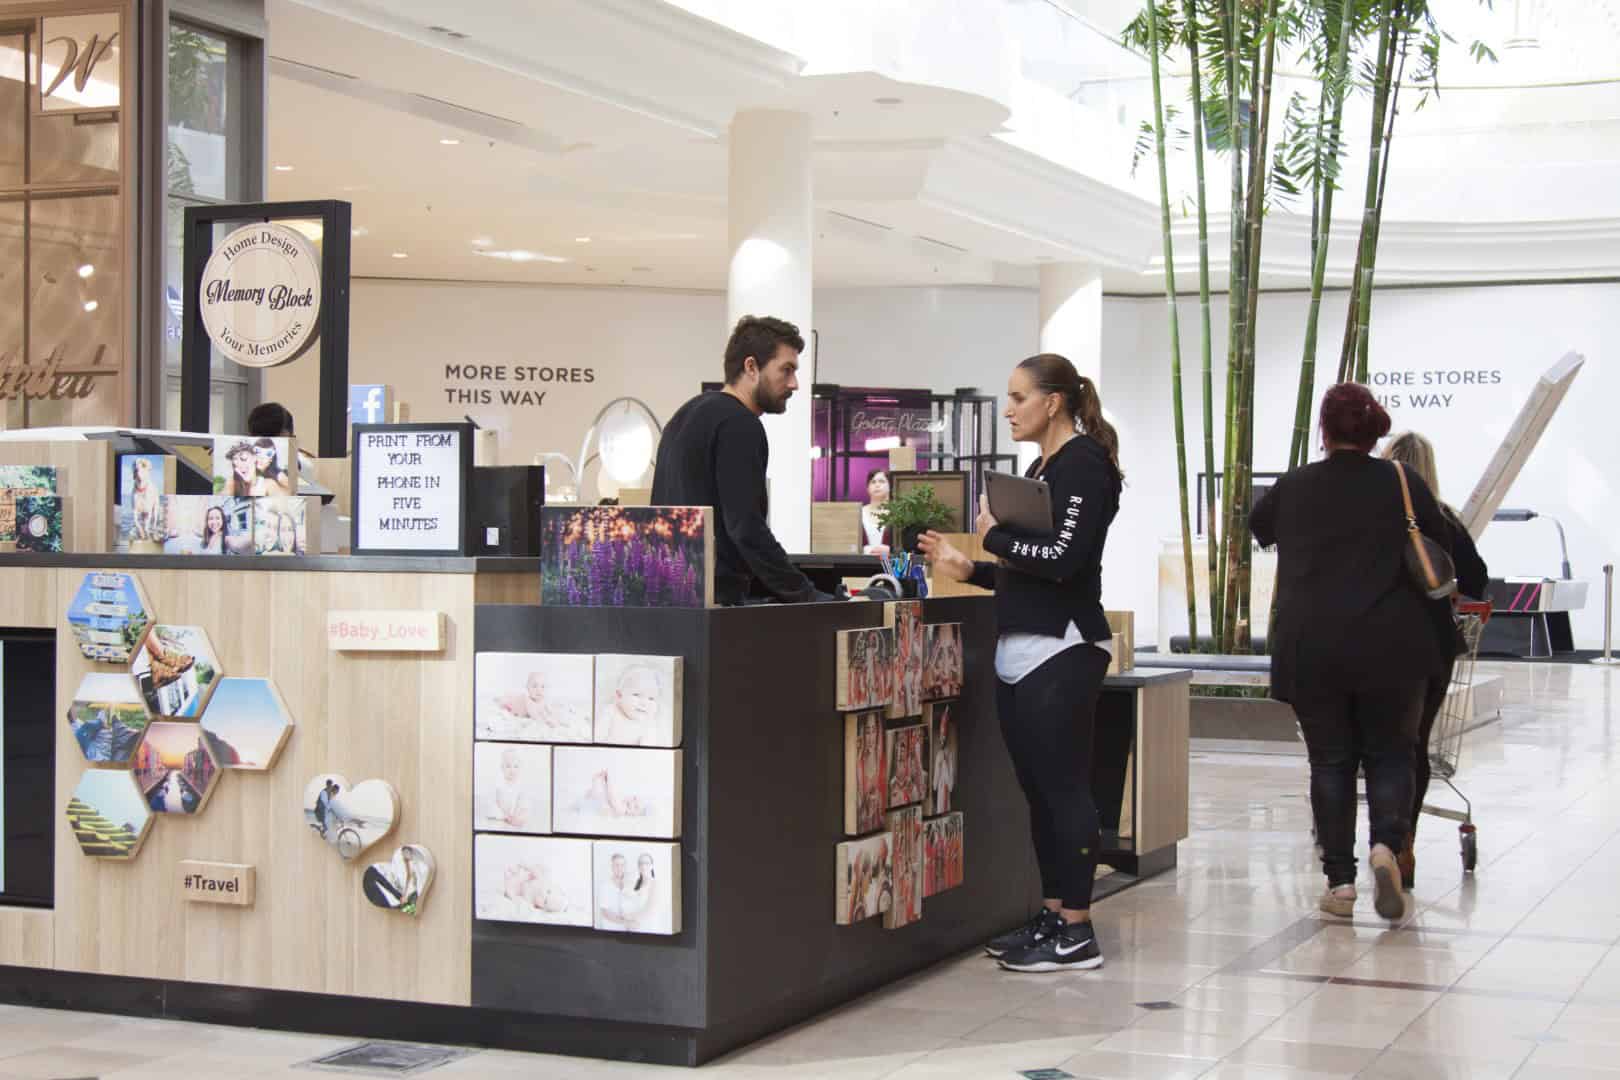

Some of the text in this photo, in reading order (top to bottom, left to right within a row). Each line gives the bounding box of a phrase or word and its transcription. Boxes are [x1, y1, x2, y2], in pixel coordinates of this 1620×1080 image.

[223, 231, 299, 261] Home Design
[206, 279, 313, 311] Memory Block
[220, 321, 302, 356] Your Memories
[445, 364, 595, 383] MORE STORES
[1423, 370, 1502, 384] STORES
[445, 388, 547, 406] THIS WAY
[1409, 394, 1454, 408] WAY
[368, 434, 452, 448] PRINT FROM
[387, 453, 422, 465] YOUR
[377, 476, 441, 489] PHONE IN
[393, 497, 422, 510] FIVE
[379, 518, 438, 531] MINUTES
[328, 621, 428, 641] #Baby_Love
[184, 874, 239, 893] #Travel
